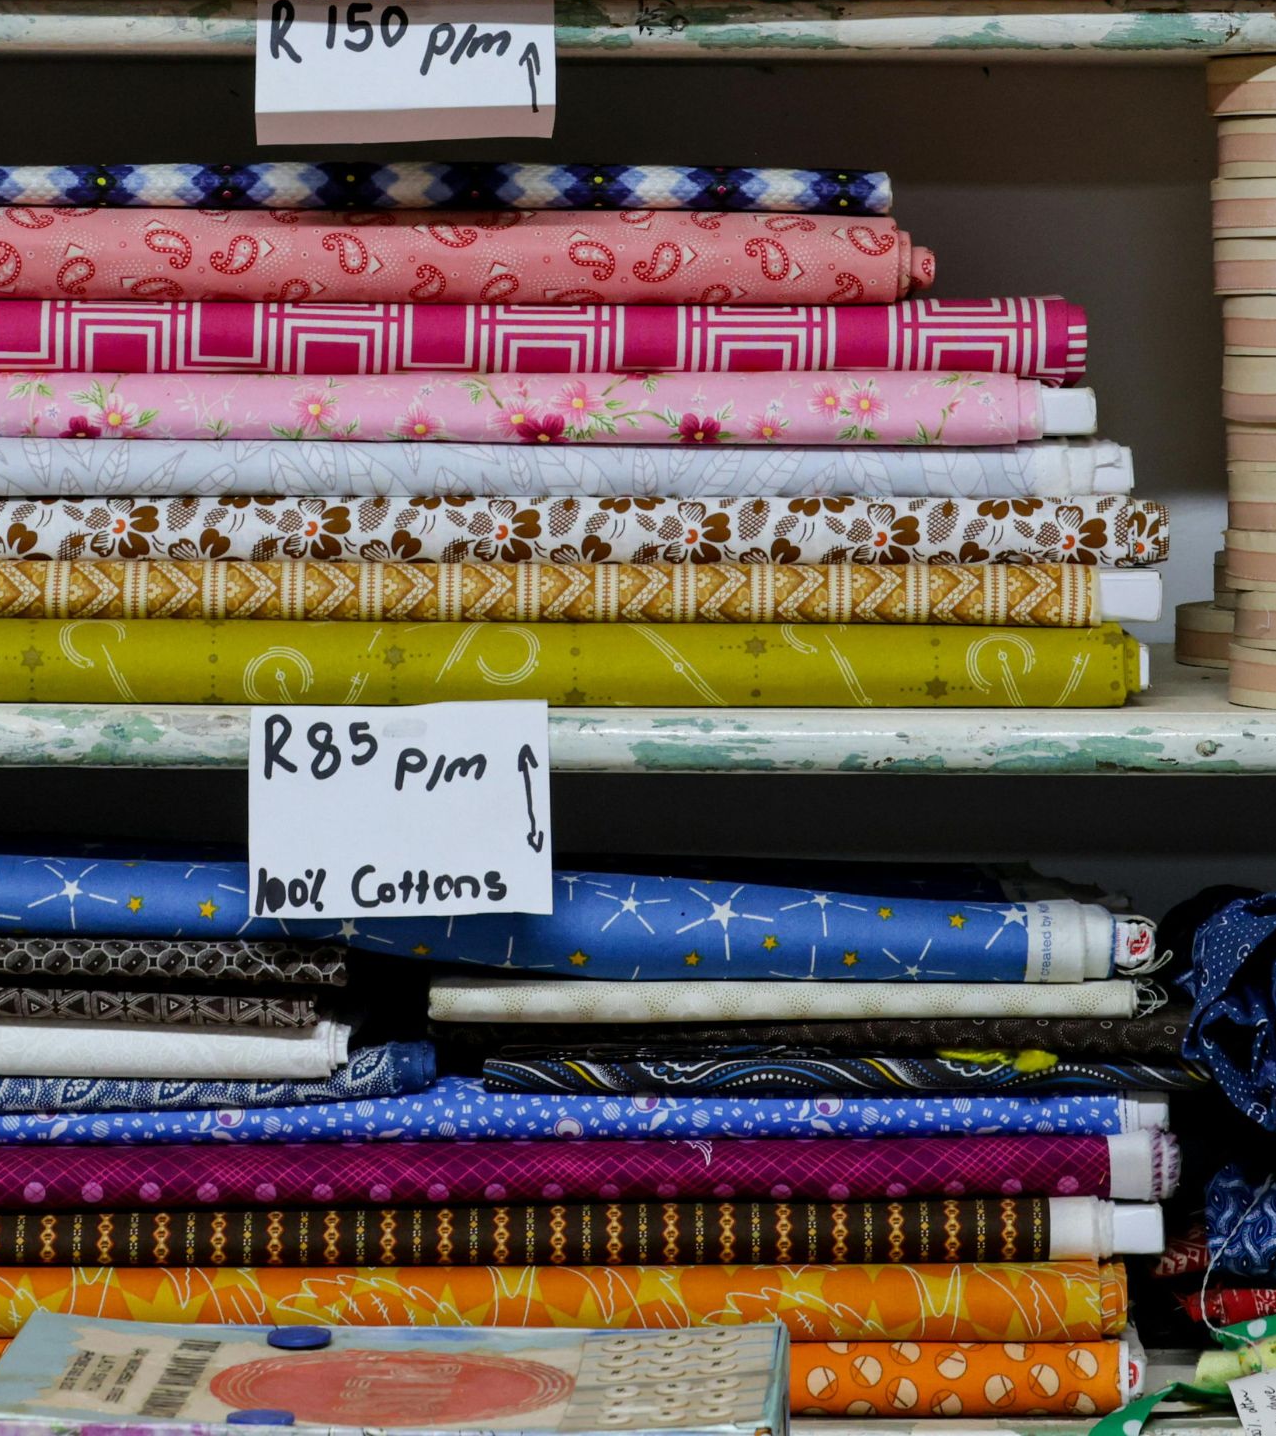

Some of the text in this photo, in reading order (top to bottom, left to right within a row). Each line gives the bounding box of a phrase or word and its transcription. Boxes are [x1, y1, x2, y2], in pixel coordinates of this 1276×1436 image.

[420, 22, 512, 77] p/m
[394, 747, 488, 792] p/m
[255, 864, 508, 916] 100% Cottons
